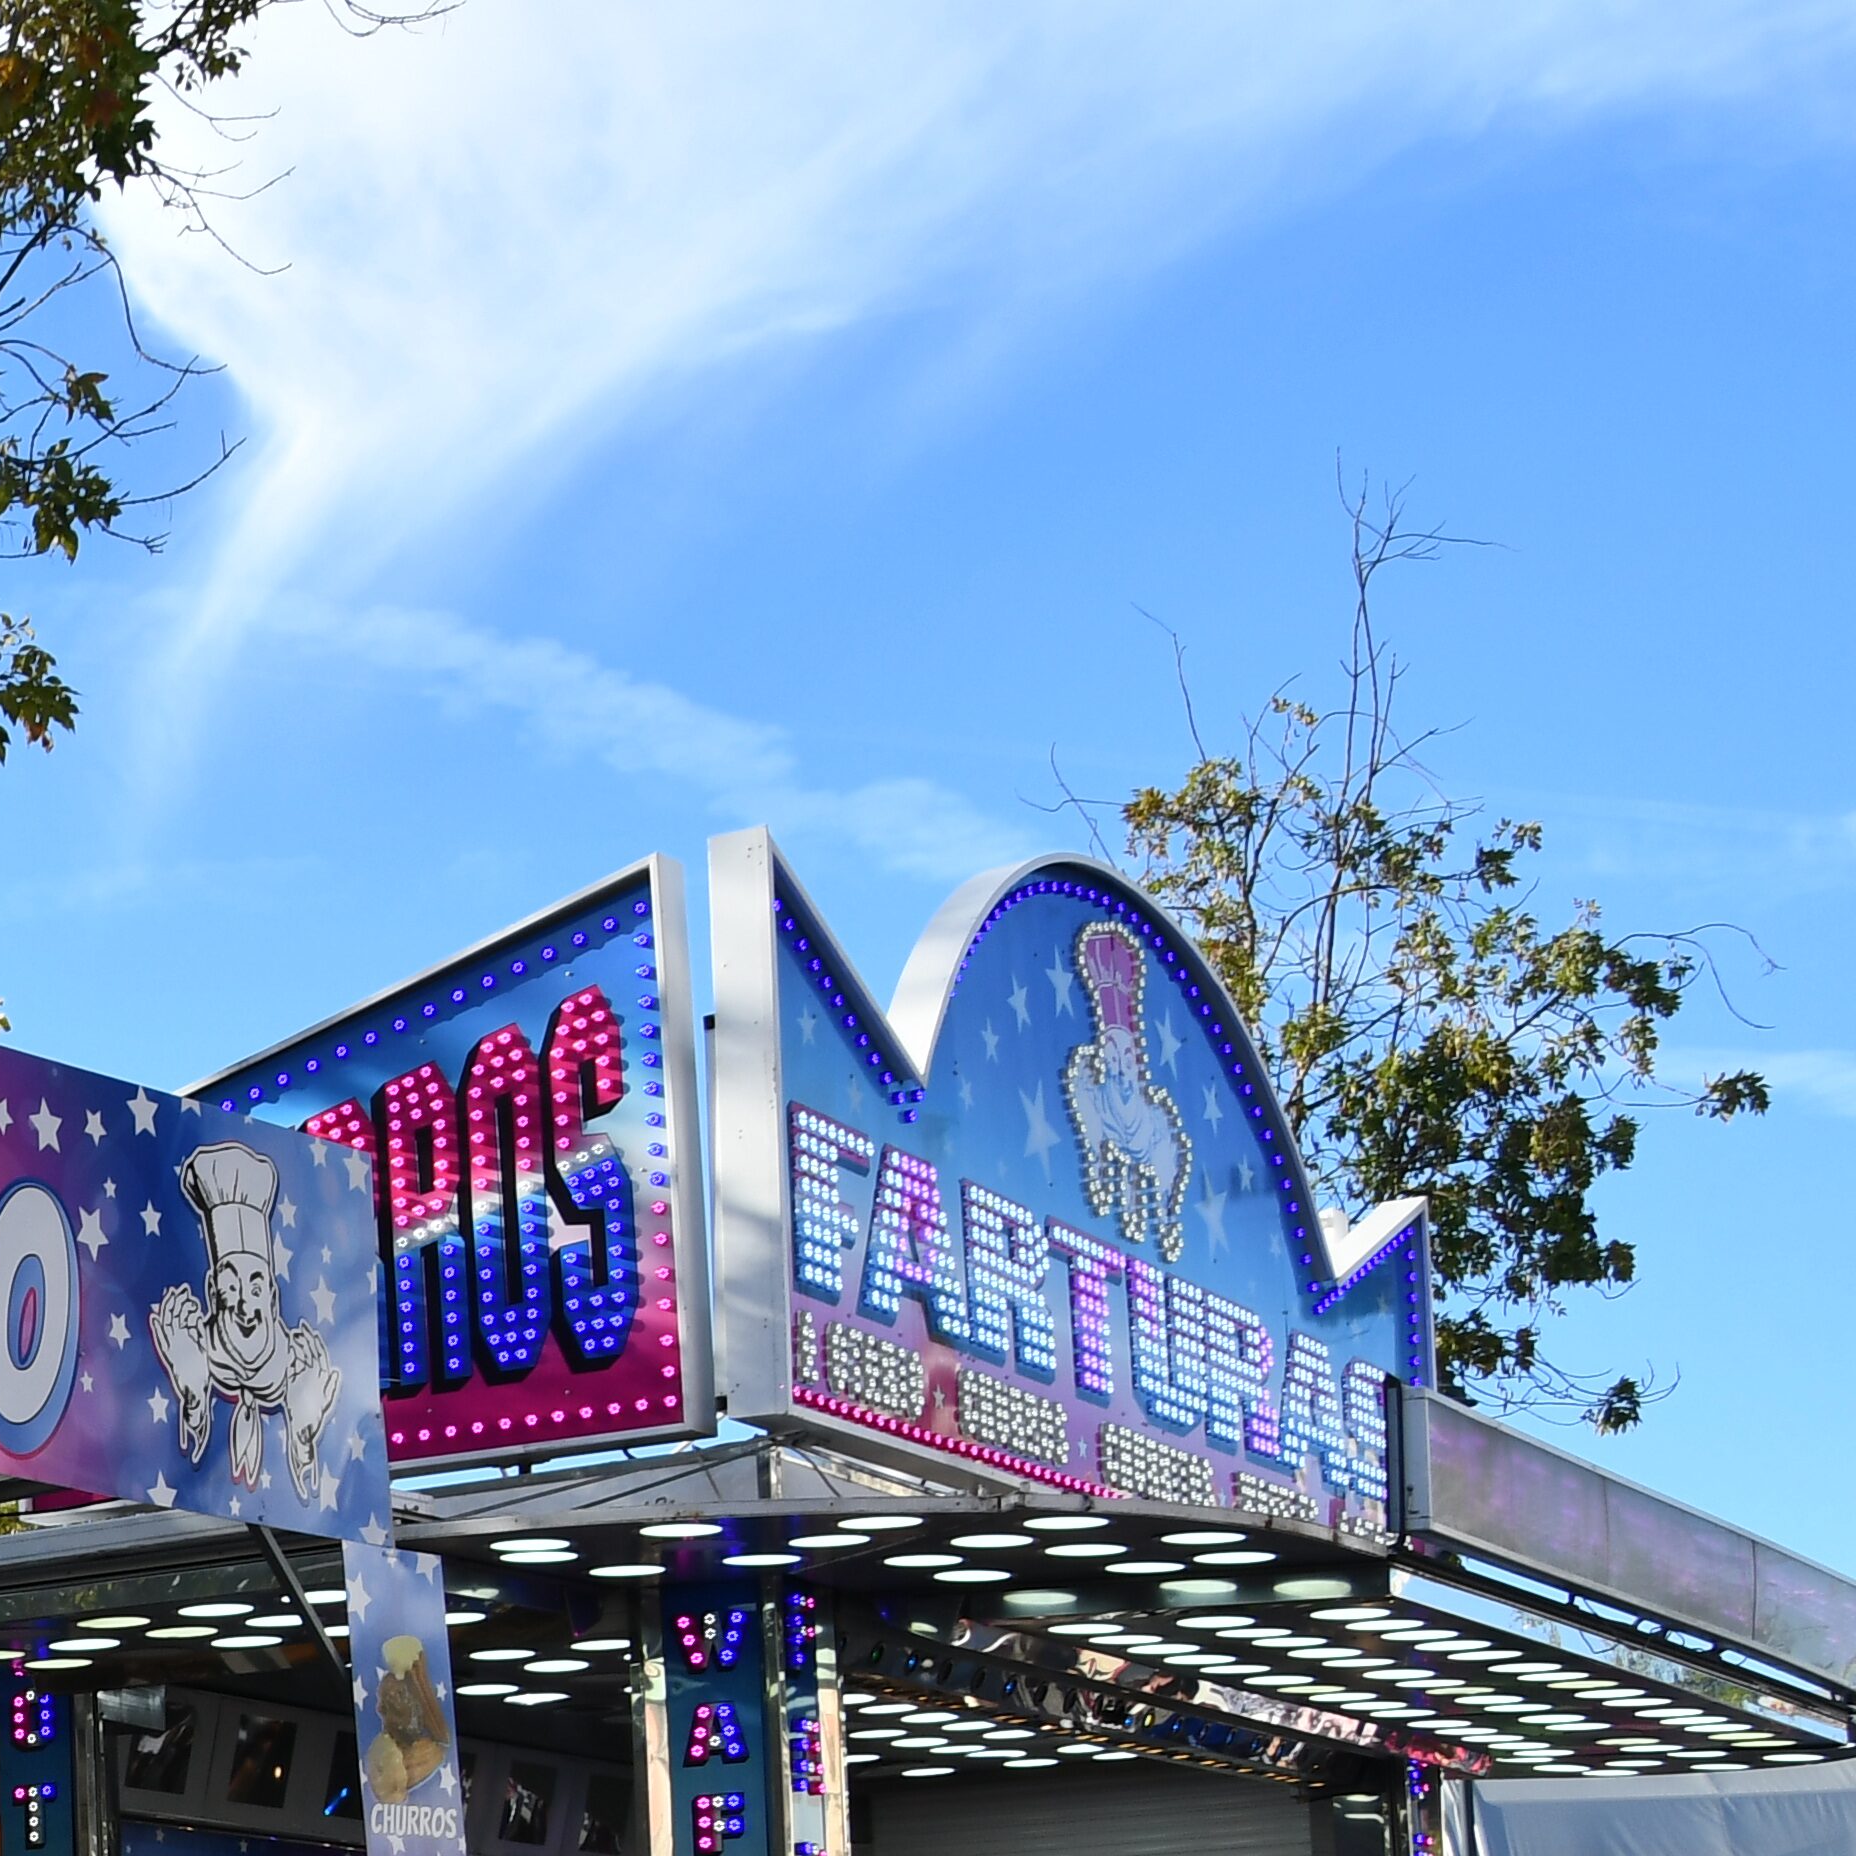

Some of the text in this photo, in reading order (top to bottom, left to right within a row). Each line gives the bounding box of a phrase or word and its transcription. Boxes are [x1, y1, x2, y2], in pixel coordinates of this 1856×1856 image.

[302, 985, 641, 1392] ROS
[790, 1102, 1386, 1500] FARTURAS
[370, 1801, 457, 1840] CHURROS
